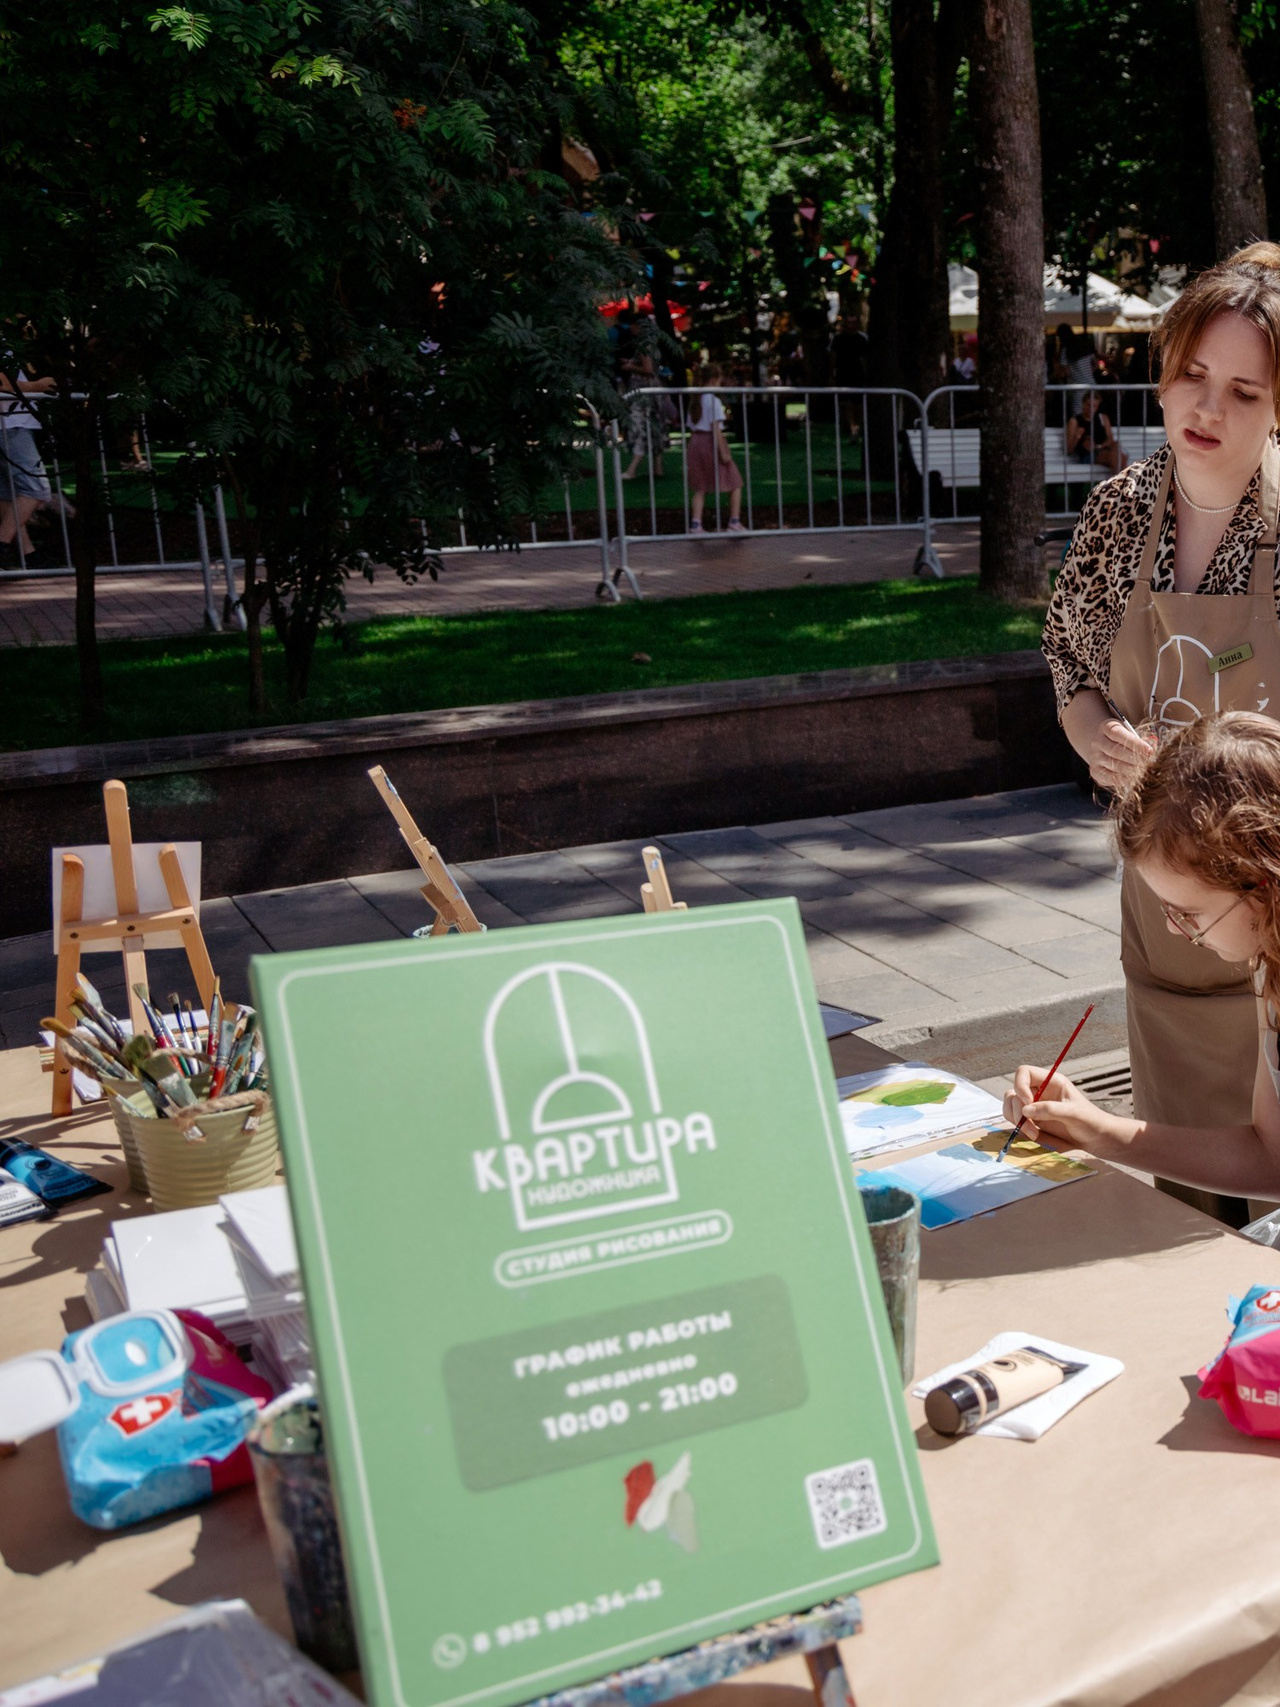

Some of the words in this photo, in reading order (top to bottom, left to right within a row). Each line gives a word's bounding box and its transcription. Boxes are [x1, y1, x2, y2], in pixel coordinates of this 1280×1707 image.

[1218, 651, 1243, 668] Анна
[473, 1111, 717, 1193] КВАРТИРА
[506, 1244, 592, 1277] СТУДИЯ
[597, 1218, 722, 1258] РИСОВАНИЯ
[513, 1334, 623, 1379] ГРАФИК
[627, 1309, 733, 1352] РАБОТЫ
[565, 1353, 698, 1398] ежедневно
[541, 1398, 630, 1441] 10:00
[658, 1371, 739, 1412] 21:00
